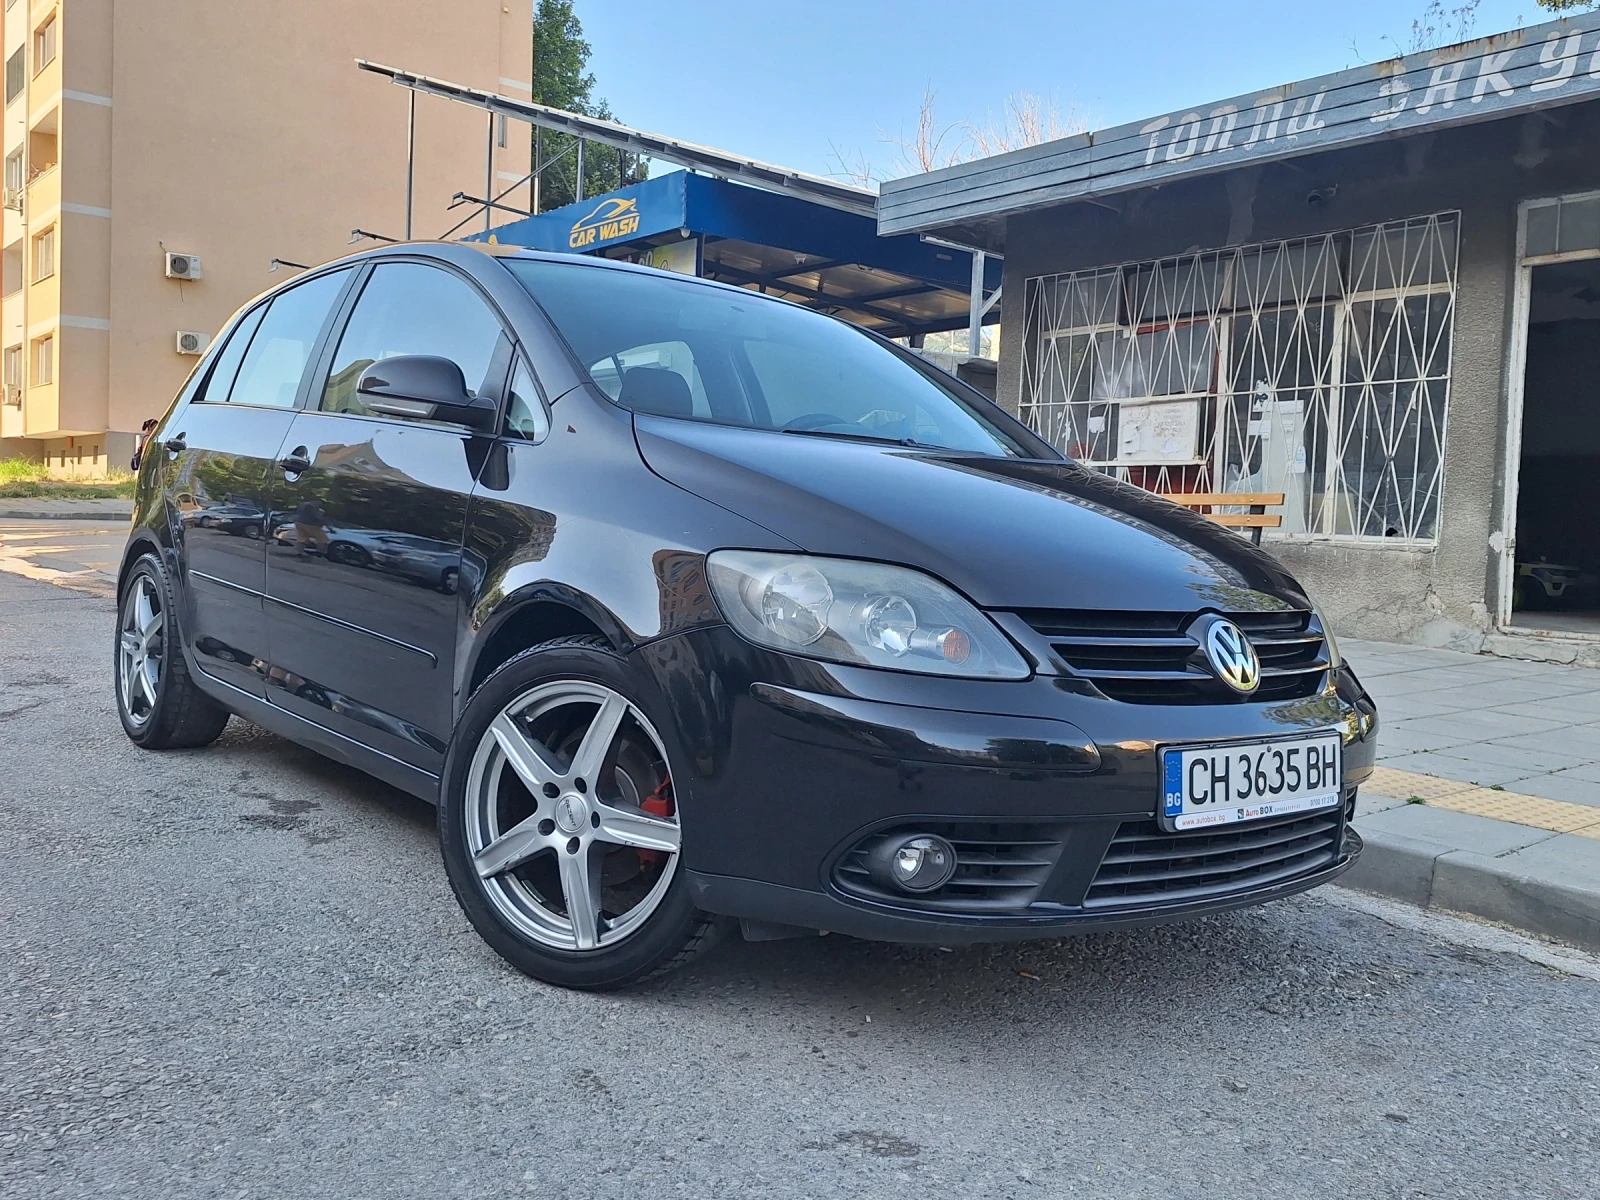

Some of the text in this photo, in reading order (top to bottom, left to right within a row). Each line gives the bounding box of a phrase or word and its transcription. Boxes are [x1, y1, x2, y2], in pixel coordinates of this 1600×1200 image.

[569, 215, 641, 249] CAR WASH
[1237, 747, 1302, 799] 3635
[1166, 792, 1181, 807] BG
[1182, 813, 1226, 826] www.autobox.bg
